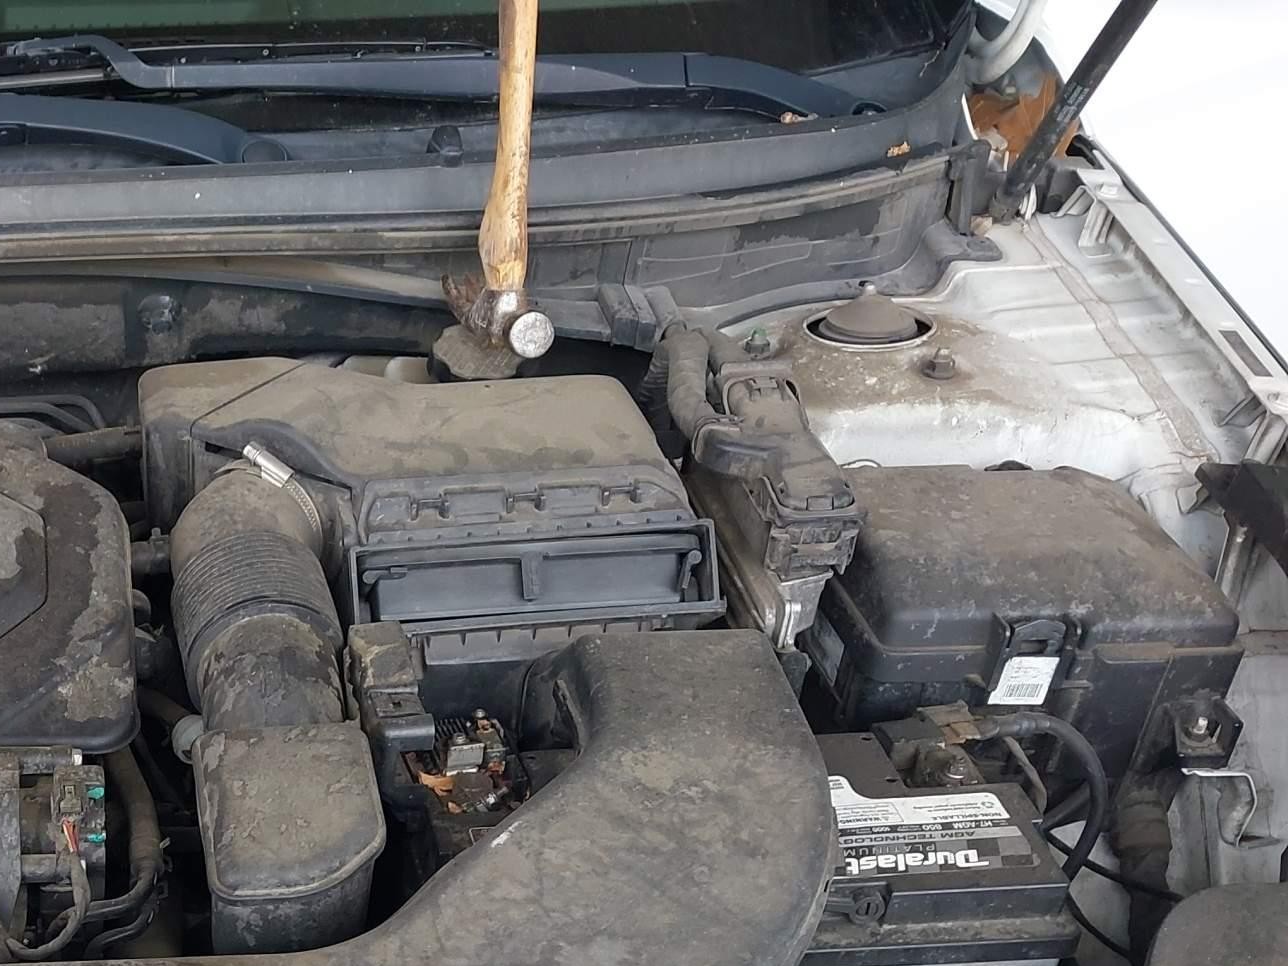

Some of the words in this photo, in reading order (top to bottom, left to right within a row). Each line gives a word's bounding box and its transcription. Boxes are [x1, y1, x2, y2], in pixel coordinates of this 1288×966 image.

[839, 833, 936, 845] TECHNOLOG
[940, 830, 976, 839] AGM
[843, 843, 935, 857] PLATINUM
[845, 849, 990, 875] Duralast
